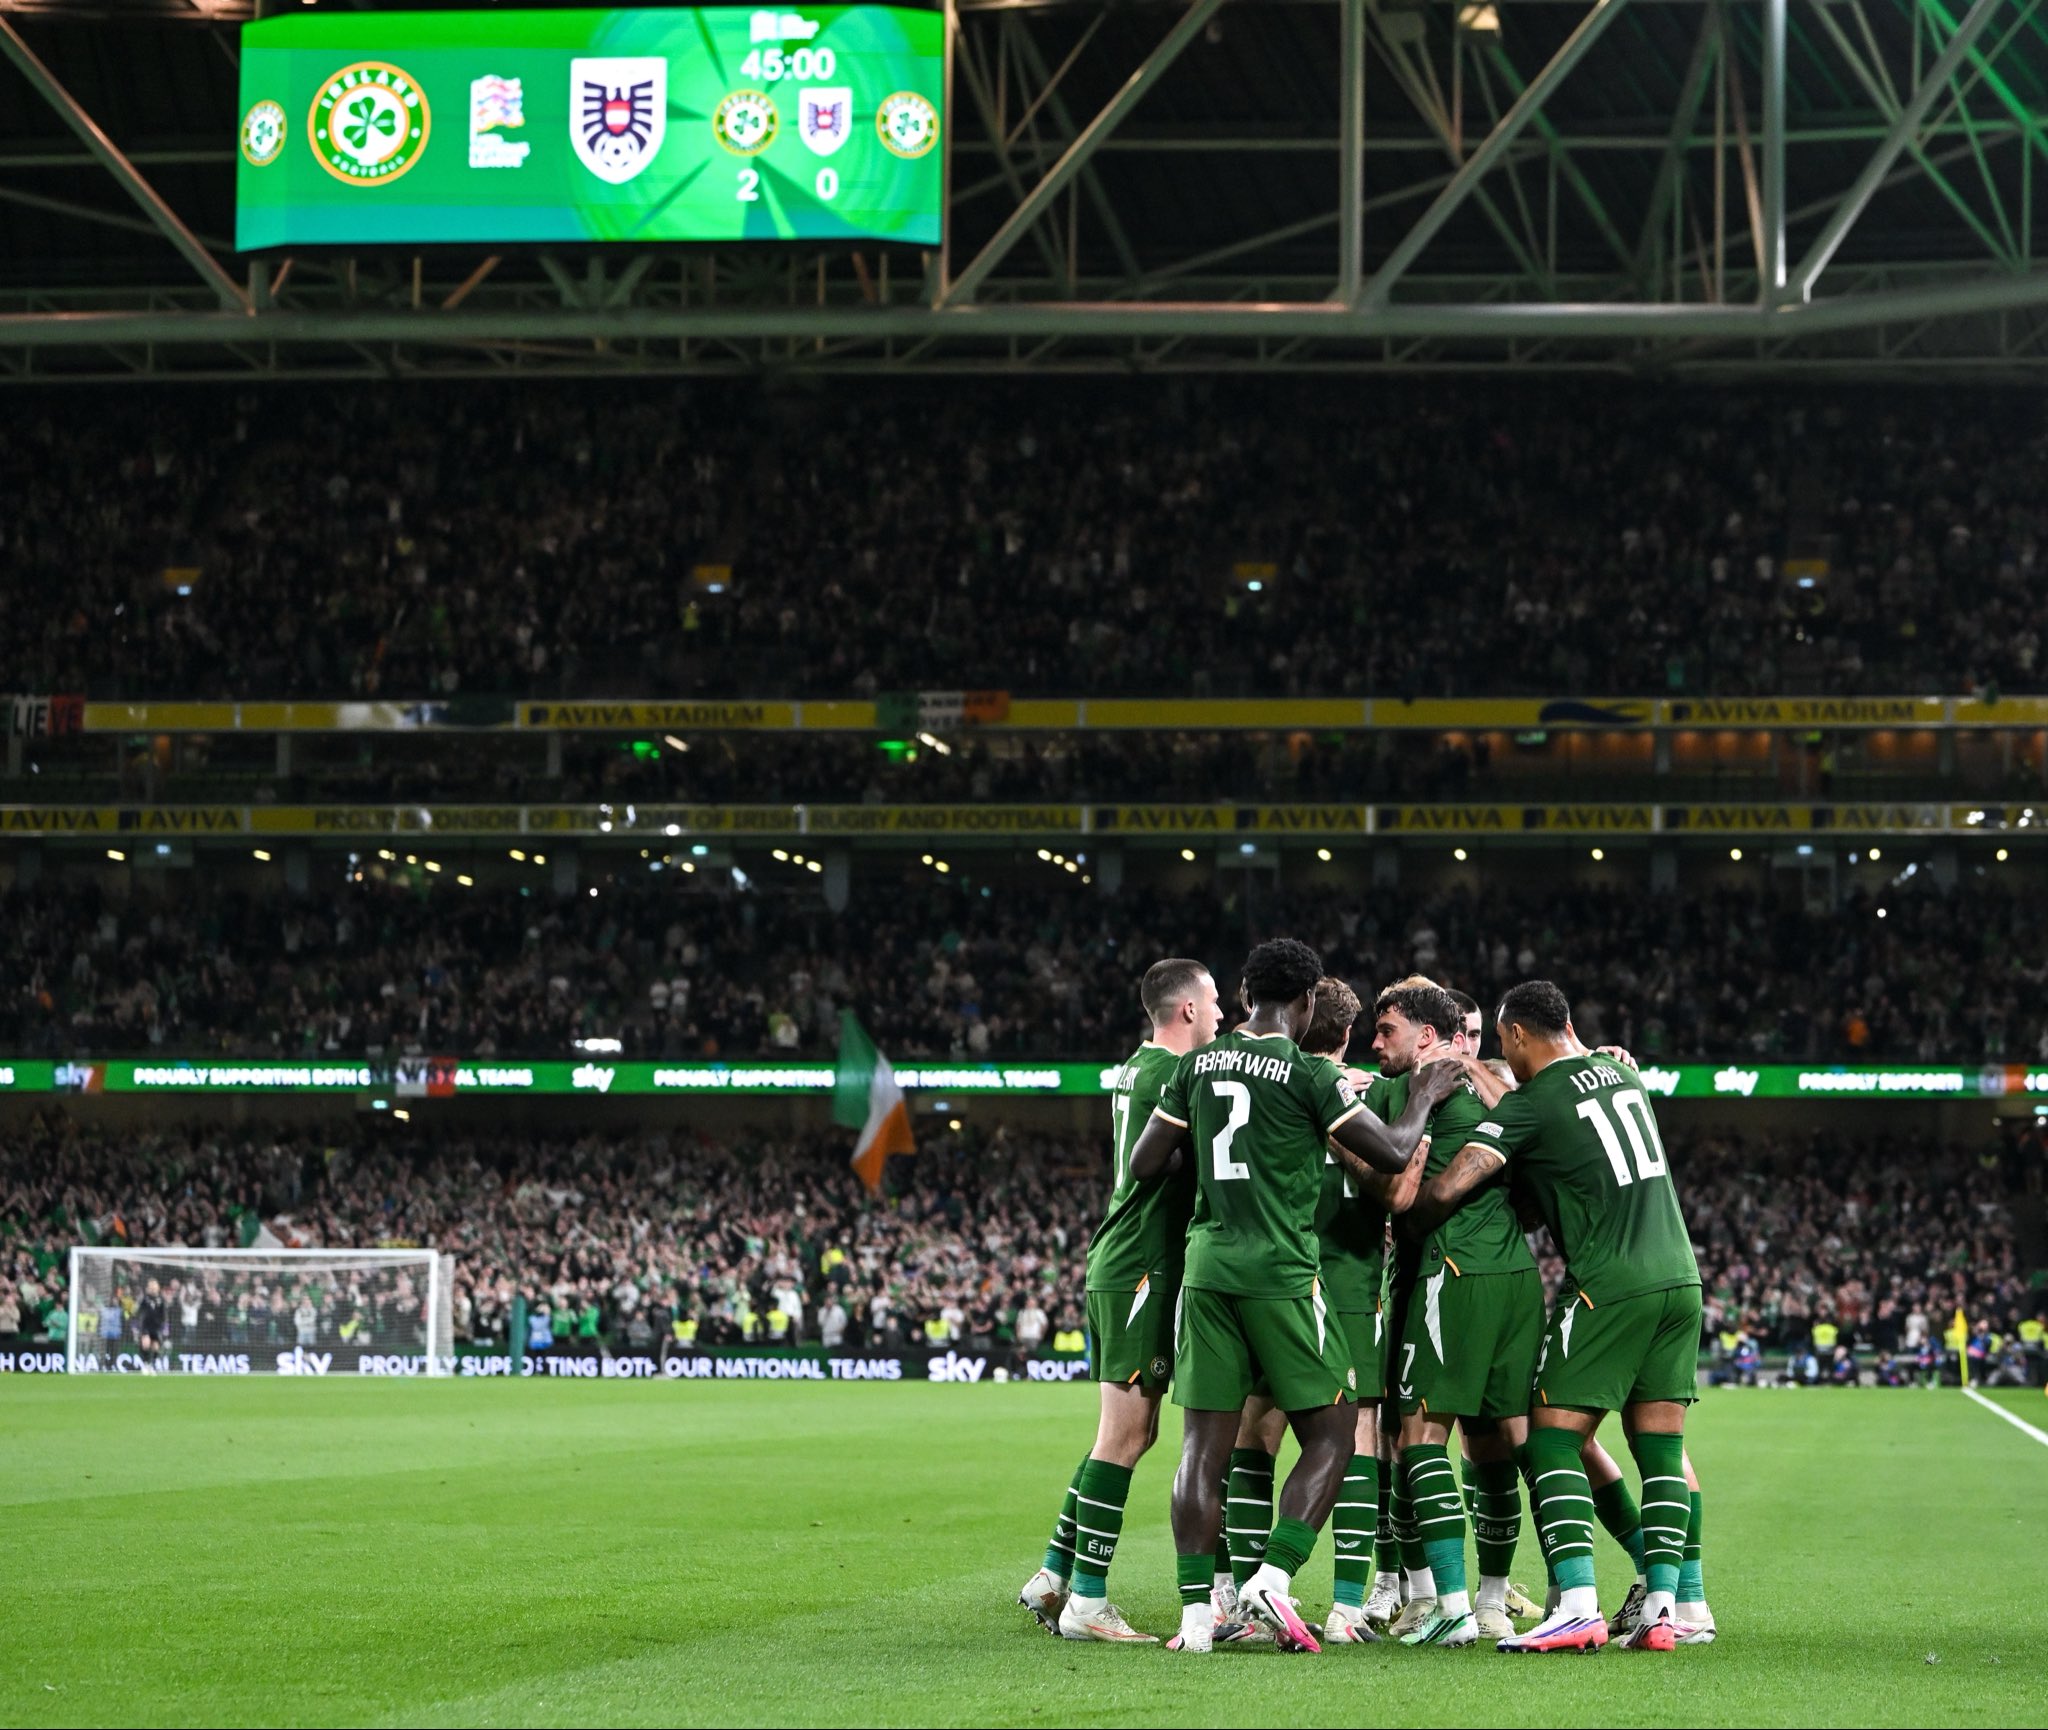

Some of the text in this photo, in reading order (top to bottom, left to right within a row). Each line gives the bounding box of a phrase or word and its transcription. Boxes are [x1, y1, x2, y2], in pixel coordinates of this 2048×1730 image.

[740, 47, 836, 80] 45:00
[736, 168, 759, 201] 2
[815, 167, 839, 200] 0
[556, 706, 764, 724] AVIVA STADIUM
[1700, 703, 1916, 721] AVIVA STADIUM
[10, 810, 100, 828] AVIVA
[151, 810, 239, 828] AVIVA
[1128, 808, 1219, 828] AVIVA
[1268, 808, 1361, 828] AVIVA
[1409, 808, 1503, 828] AVIVA
[1553, 808, 1649, 828] AVIVA
[1699, 808, 1791, 828] AVIVA
[134, 1068, 208, 1086] PROUDLY
[209, 1068, 311, 1086] SUPPORTING
[477, 1069, 533, 1086] TEAMS
[572, 1063, 615, 1093] sky
[1195, 1051, 1293, 1084] ABANKWAH
[894, 1071, 918, 1087] UR
[1569, 1066, 1624, 1094] IDAH
[1714, 1066, 1759, 1096] sky
[1212, 1080, 1250, 1181] 2
[1575, 1089, 1667, 1187] 10
[19, 1352, 65, 1373] OUR
[178, 1353, 250, 1374] TEAMS
[664, 1356, 713, 1377] OUR
[716, 1357, 825, 1378] NATIONAL
[828, 1357, 902, 1379] TEAMS
[928, 1350, 986, 1382] sky
[1402, 1343, 1416, 1382] 7
